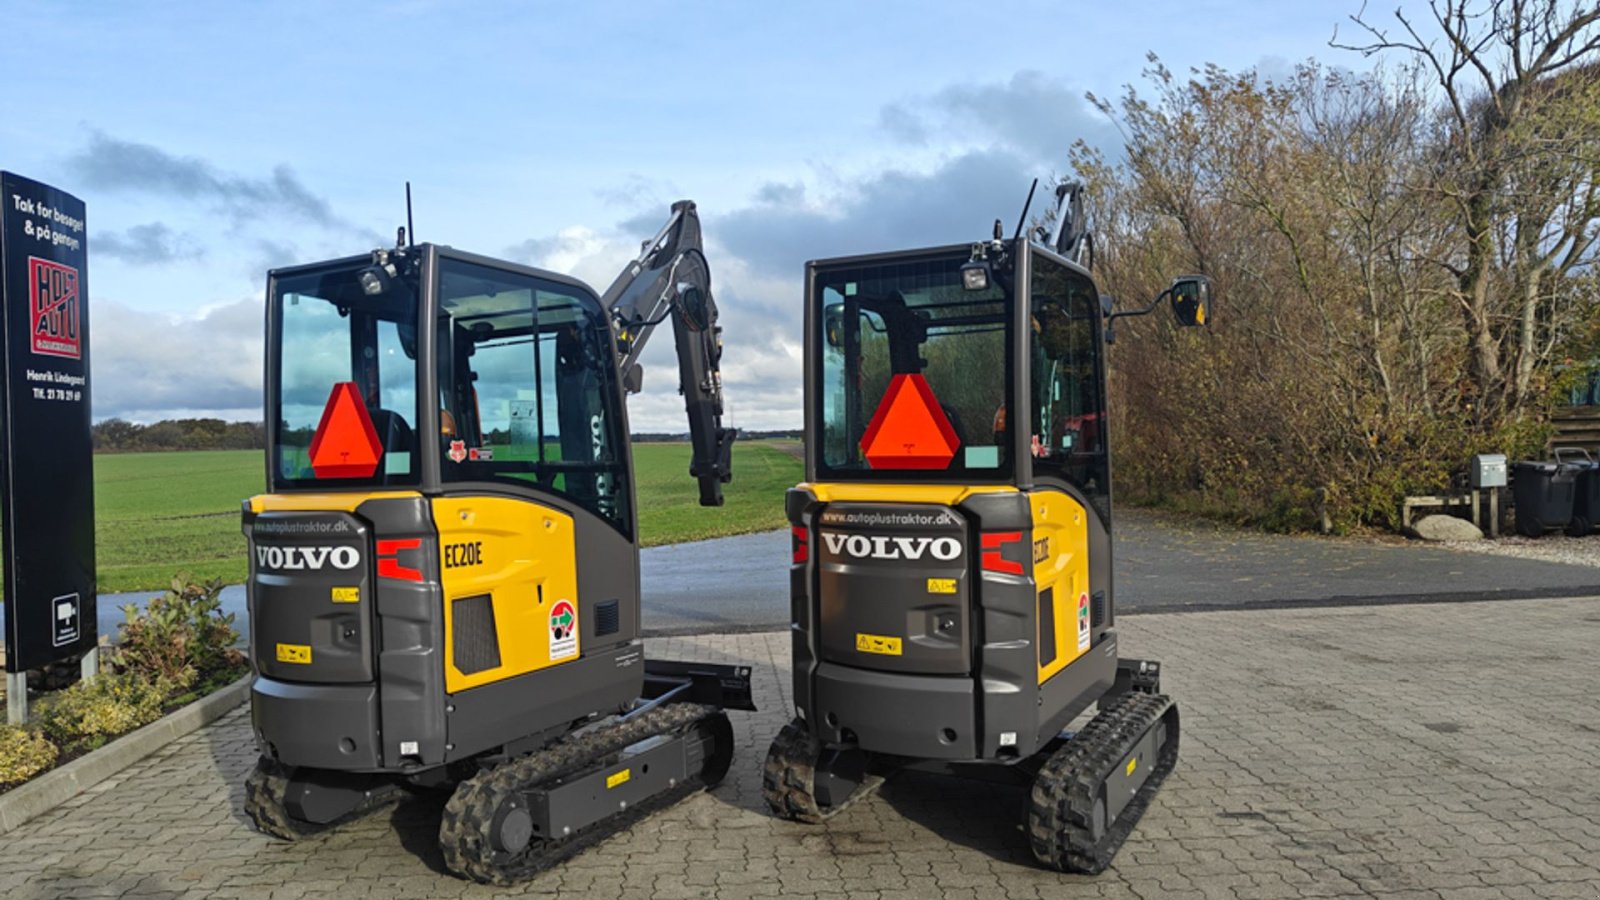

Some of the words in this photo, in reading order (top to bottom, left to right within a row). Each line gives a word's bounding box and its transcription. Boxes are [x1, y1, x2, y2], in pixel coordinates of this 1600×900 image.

[12, 194, 35, 214] Tak
[37, 201, 53, 219] for
[24, 219, 35, 236] &
[36, 224, 51, 240] på
[52, 231, 80, 251] gensyn
[36, 264, 75, 312] HOLT
[36, 295, 77, 340] AUTO
[26, 369, 54, 381] Henrik
[823, 511, 952, 525] www.autoplustraktor.dk
[255, 545, 360, 569] VOLVO
[444, 541, 483, 568] EC20E
[821, 532, 963, 560] VOLVO
